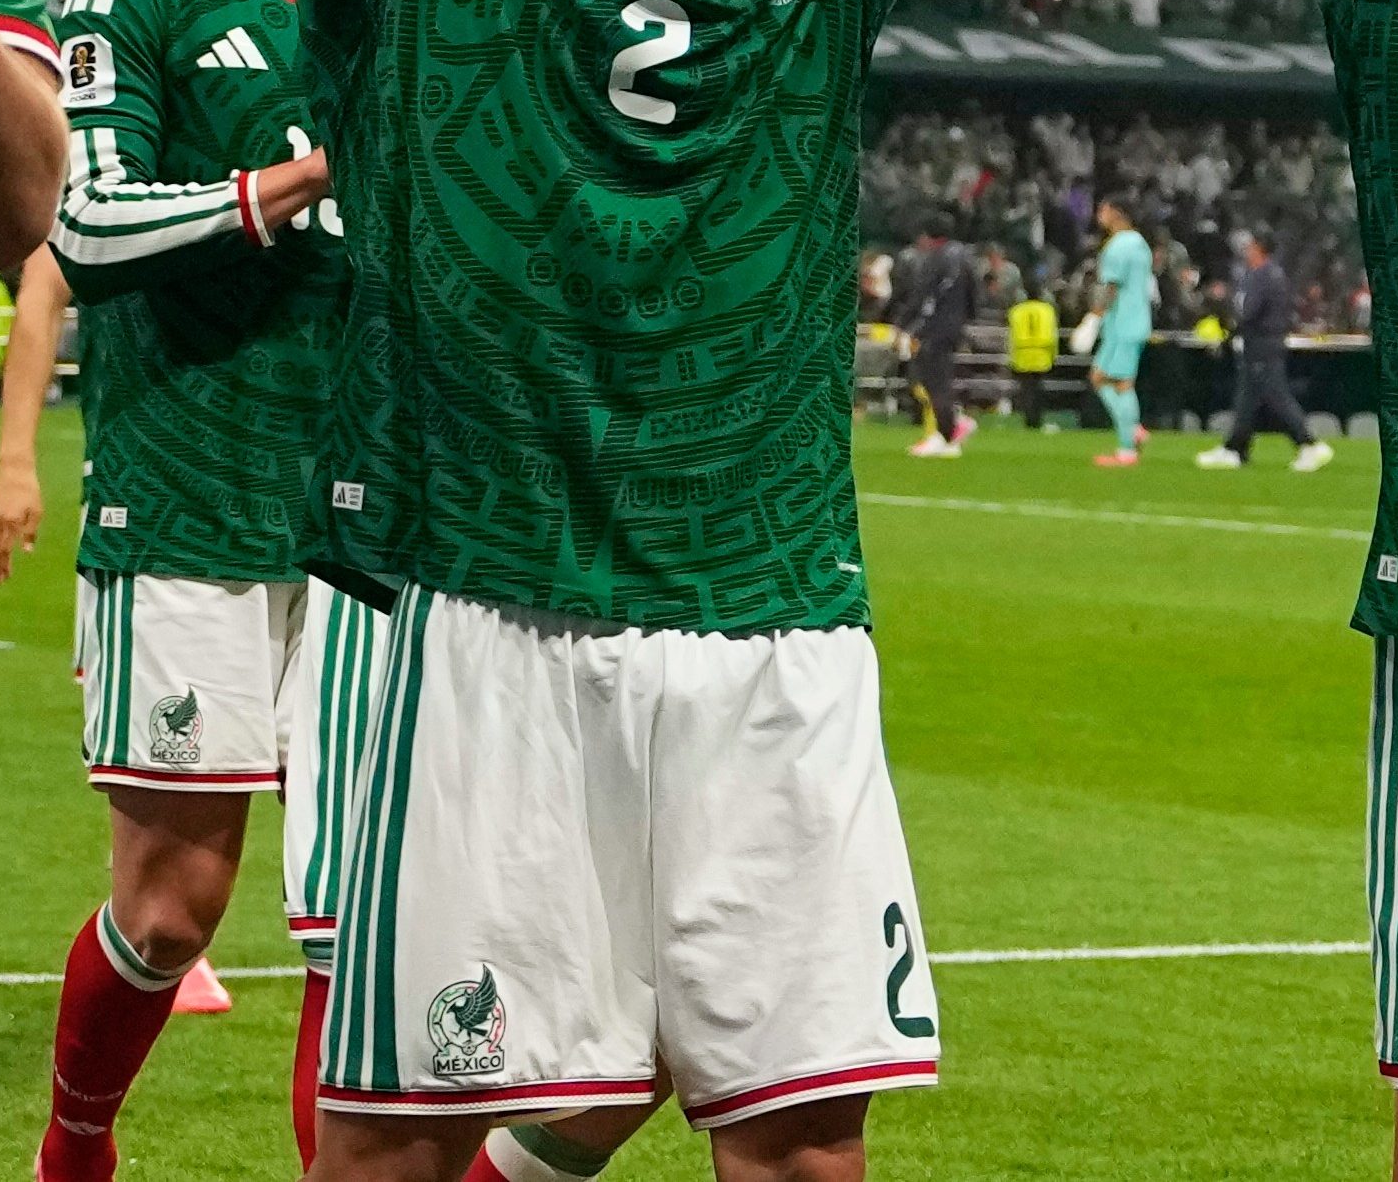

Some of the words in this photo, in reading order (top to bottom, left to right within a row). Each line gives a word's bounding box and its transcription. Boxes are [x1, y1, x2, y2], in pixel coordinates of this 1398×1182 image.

[152, 748, 198, 760] MÉXICO
[883, 901, 935, 1040] 2
[436, 1051, 504, 1072] MÉXICO
